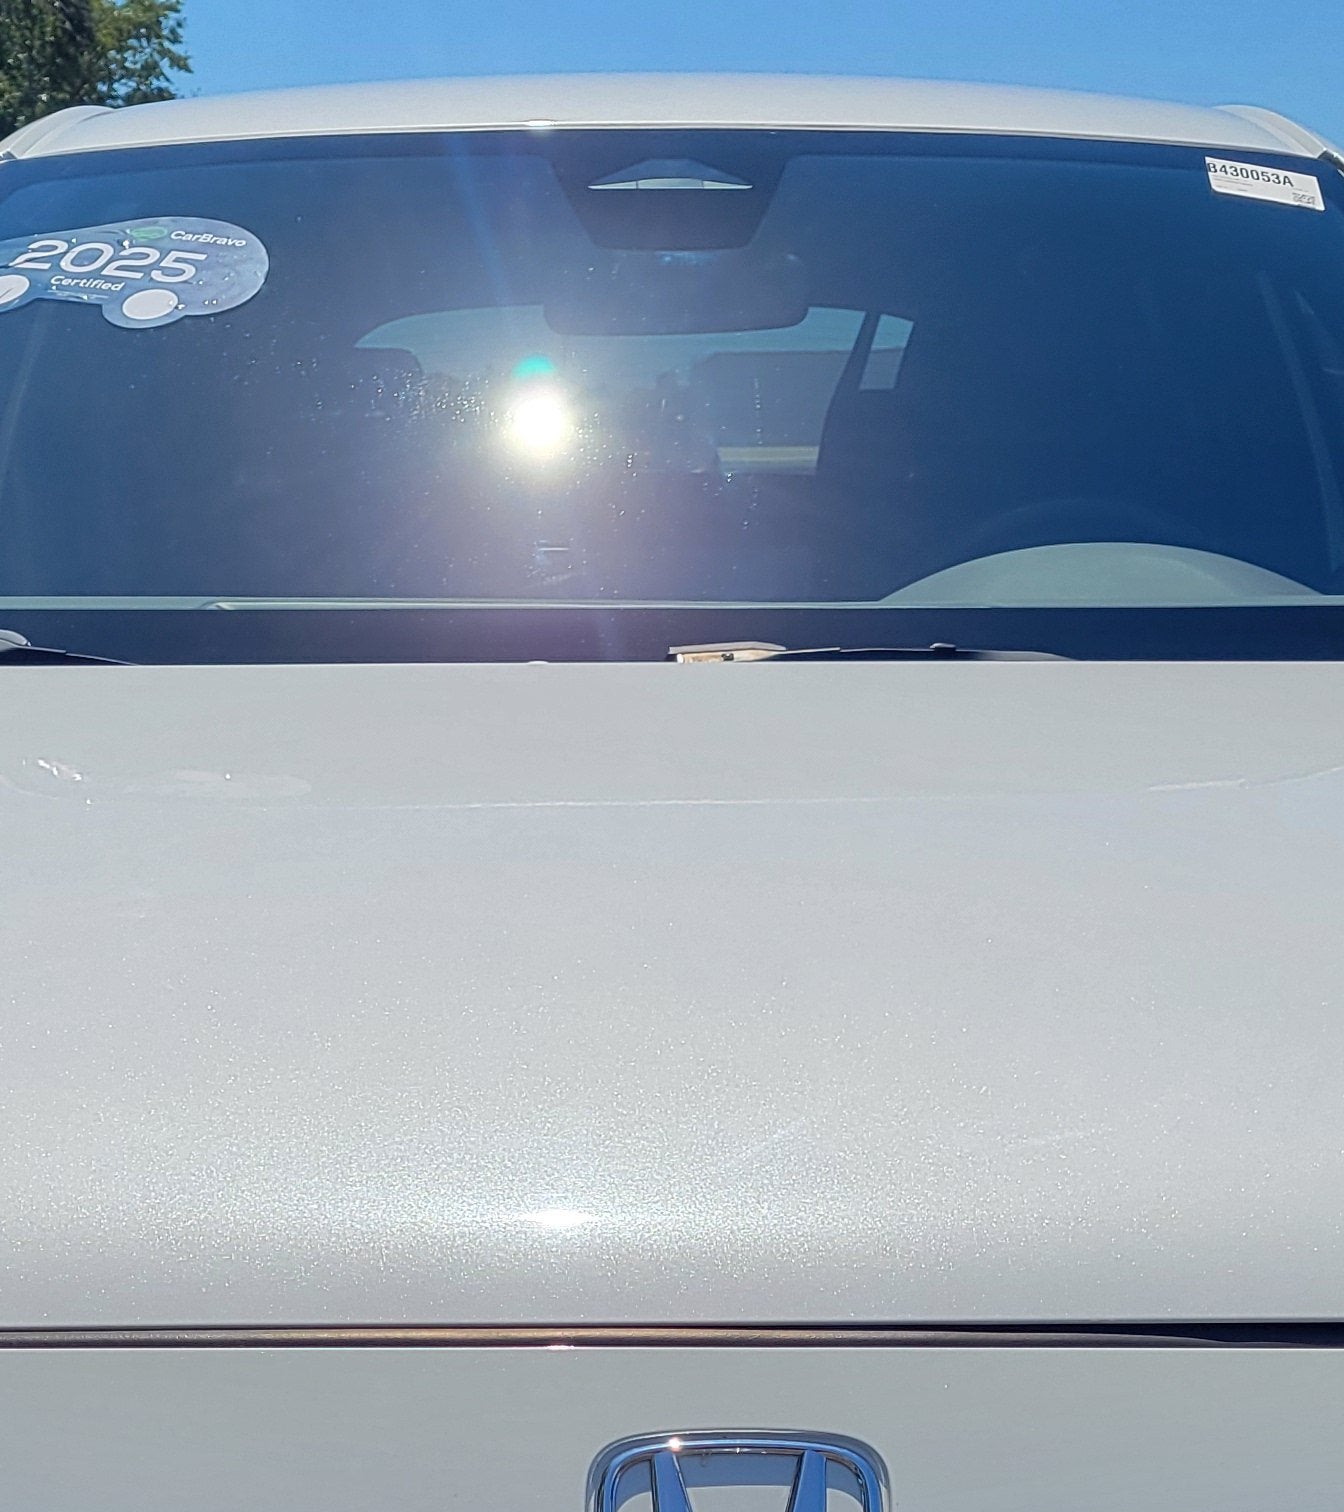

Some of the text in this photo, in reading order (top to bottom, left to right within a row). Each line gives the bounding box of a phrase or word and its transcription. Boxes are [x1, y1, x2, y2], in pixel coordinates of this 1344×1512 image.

[1207, 162, 1294, 188] B430053A
[170, 230, 247, 247] CarBravo
[9, 239, 207, 283] 2025
[50, 275, 126, 291] Certified
